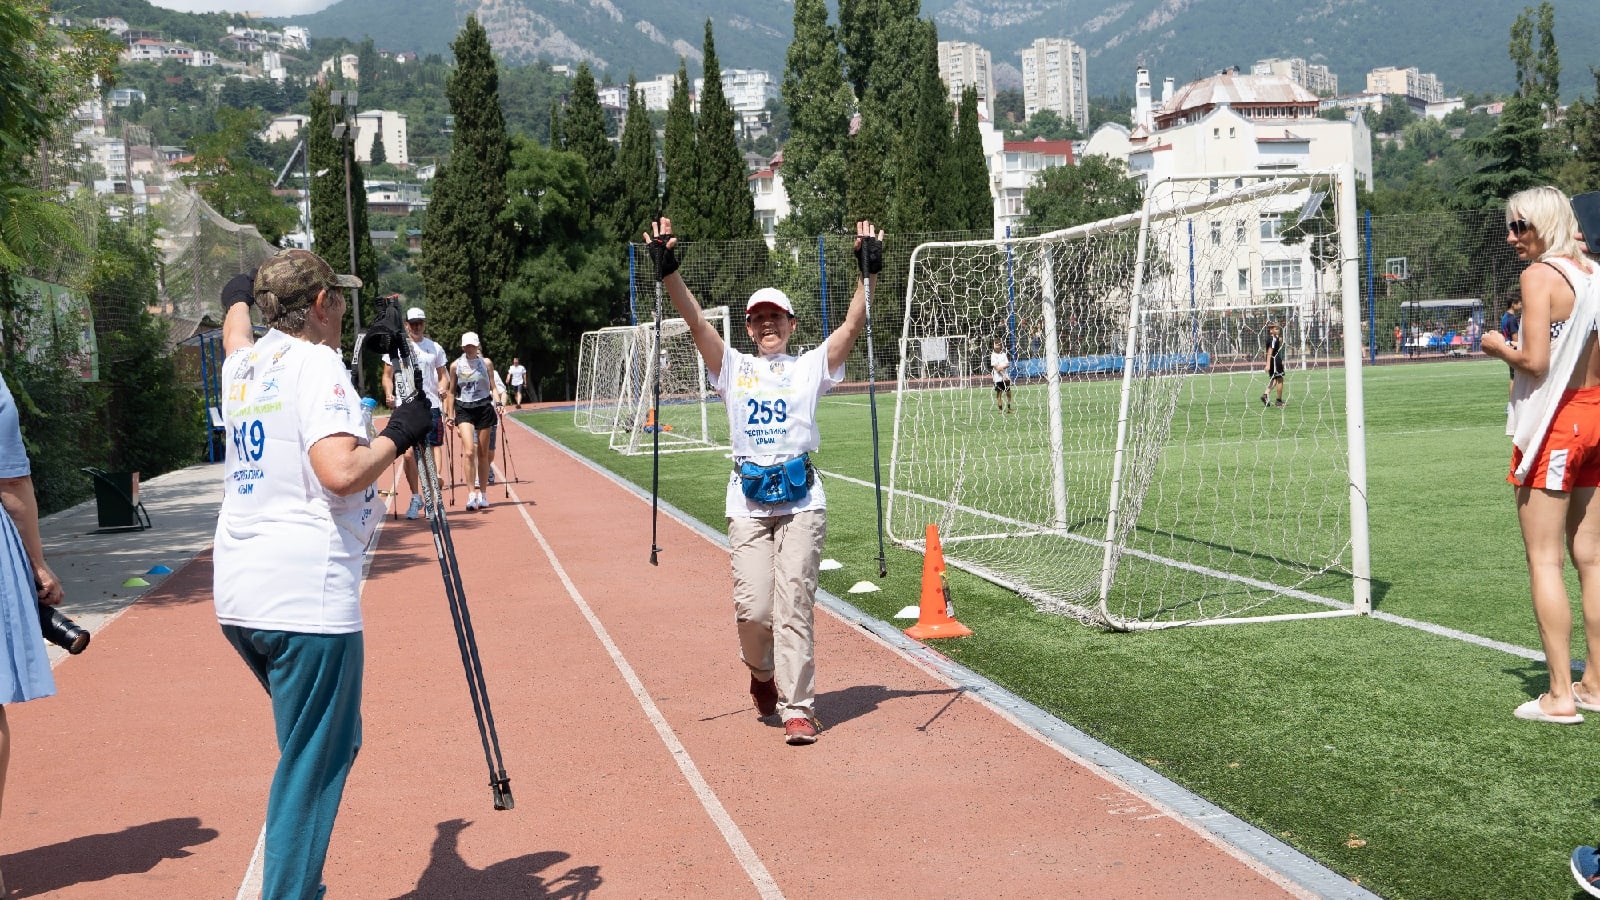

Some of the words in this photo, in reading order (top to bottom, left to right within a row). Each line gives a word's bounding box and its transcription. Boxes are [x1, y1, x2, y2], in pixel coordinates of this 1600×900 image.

[747, 398, 787, 425] 259
[745, 428, 787, 437] РЕСПУБЛИКА
[755, 437, 776, 446] КРЫМ
[233, 469, 265, 481] РЕБЛИКА
